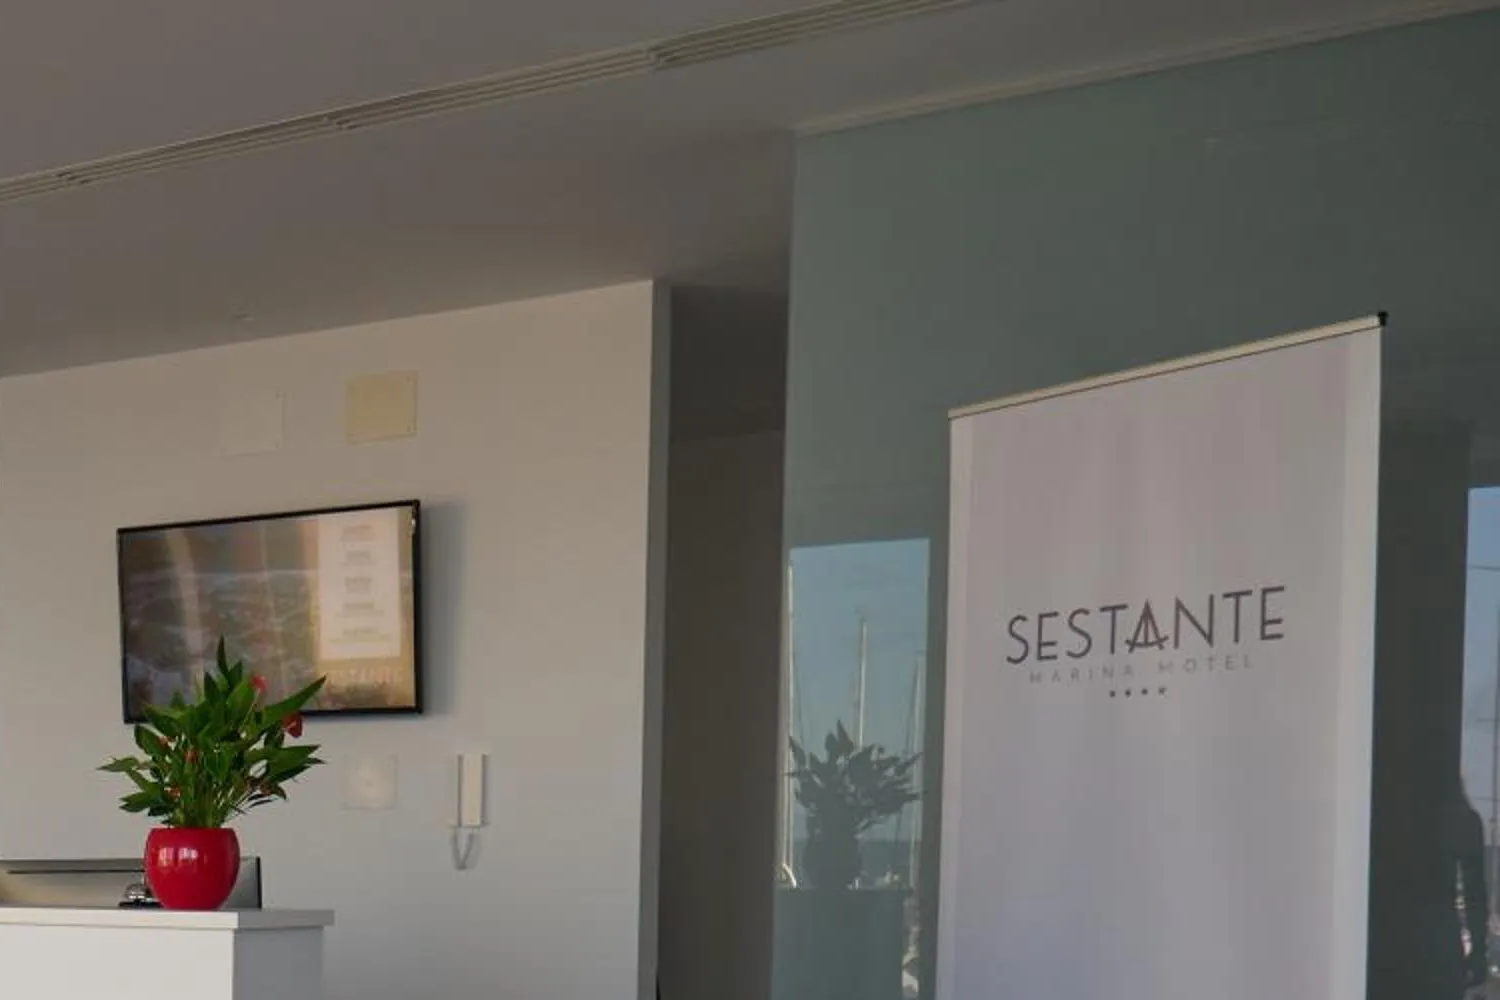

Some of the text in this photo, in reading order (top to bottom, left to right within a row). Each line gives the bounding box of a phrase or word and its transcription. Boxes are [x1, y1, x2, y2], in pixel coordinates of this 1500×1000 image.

[1006, 585, 1285, 664] SESTANTE
[1029, 654, 1254, 684] MARINA MOTEL
